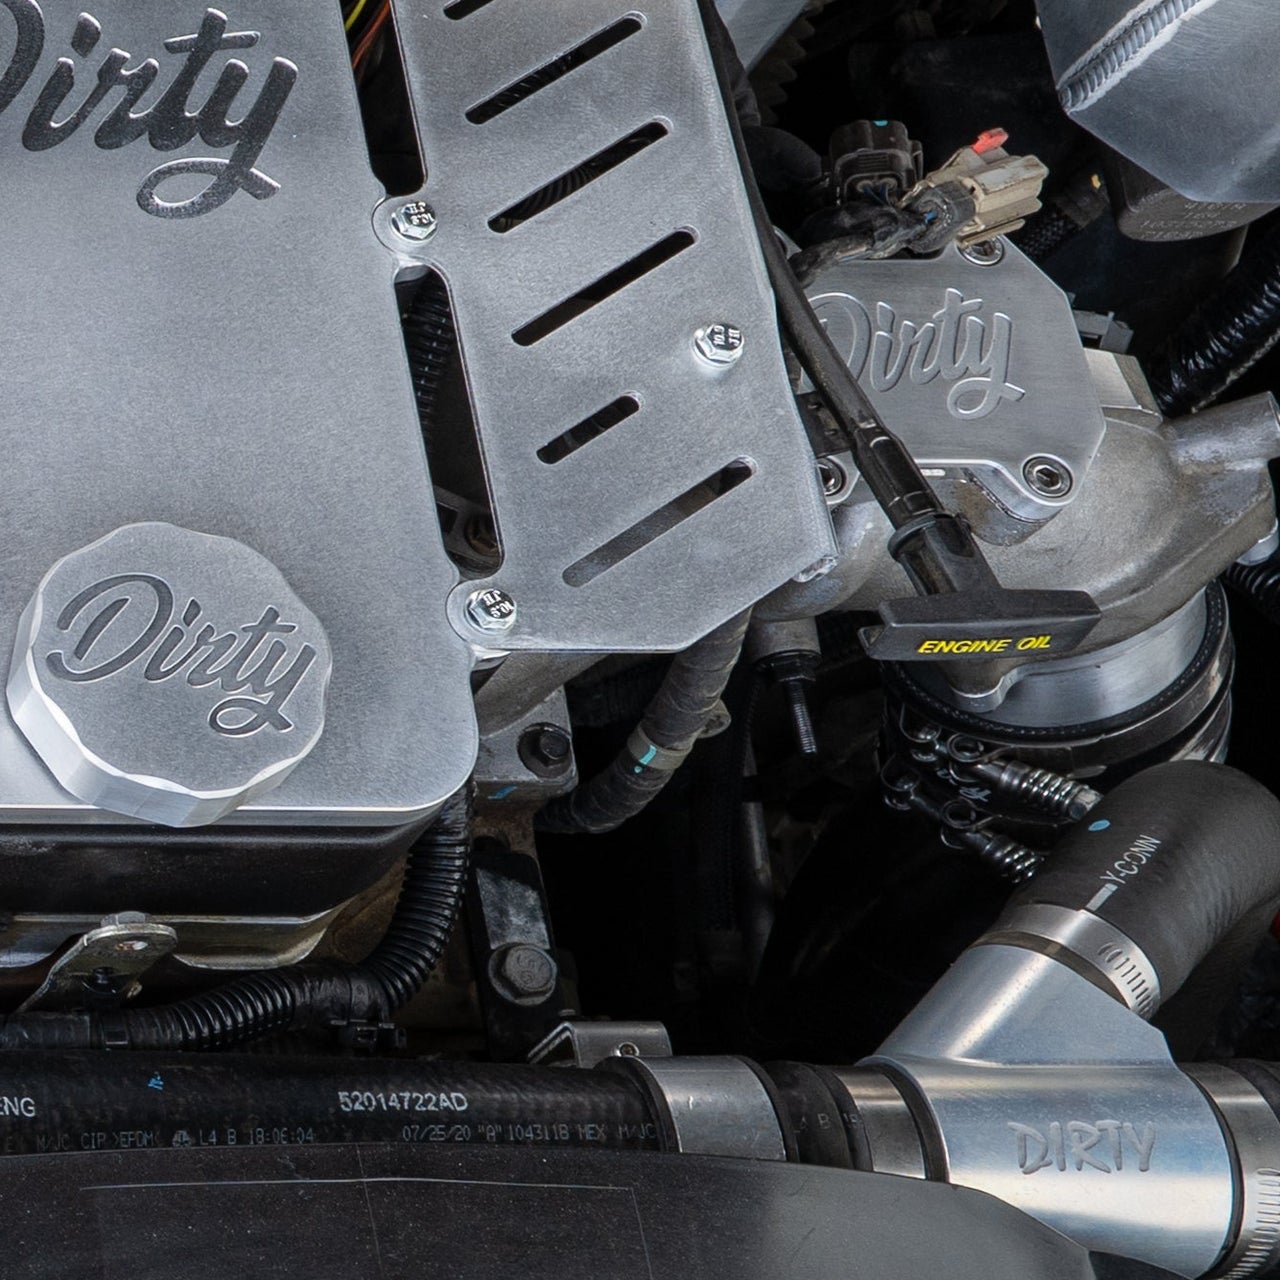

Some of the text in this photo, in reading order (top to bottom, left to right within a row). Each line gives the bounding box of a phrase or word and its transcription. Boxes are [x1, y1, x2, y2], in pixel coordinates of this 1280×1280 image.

[45, 572, 317, 738] Dirty
[917, 635, 1052, 654] ENGINE OIL
[338, 1091, 469, 1112] 52014722AD
[1007, 1120, 1157, 1175] DIRTY
